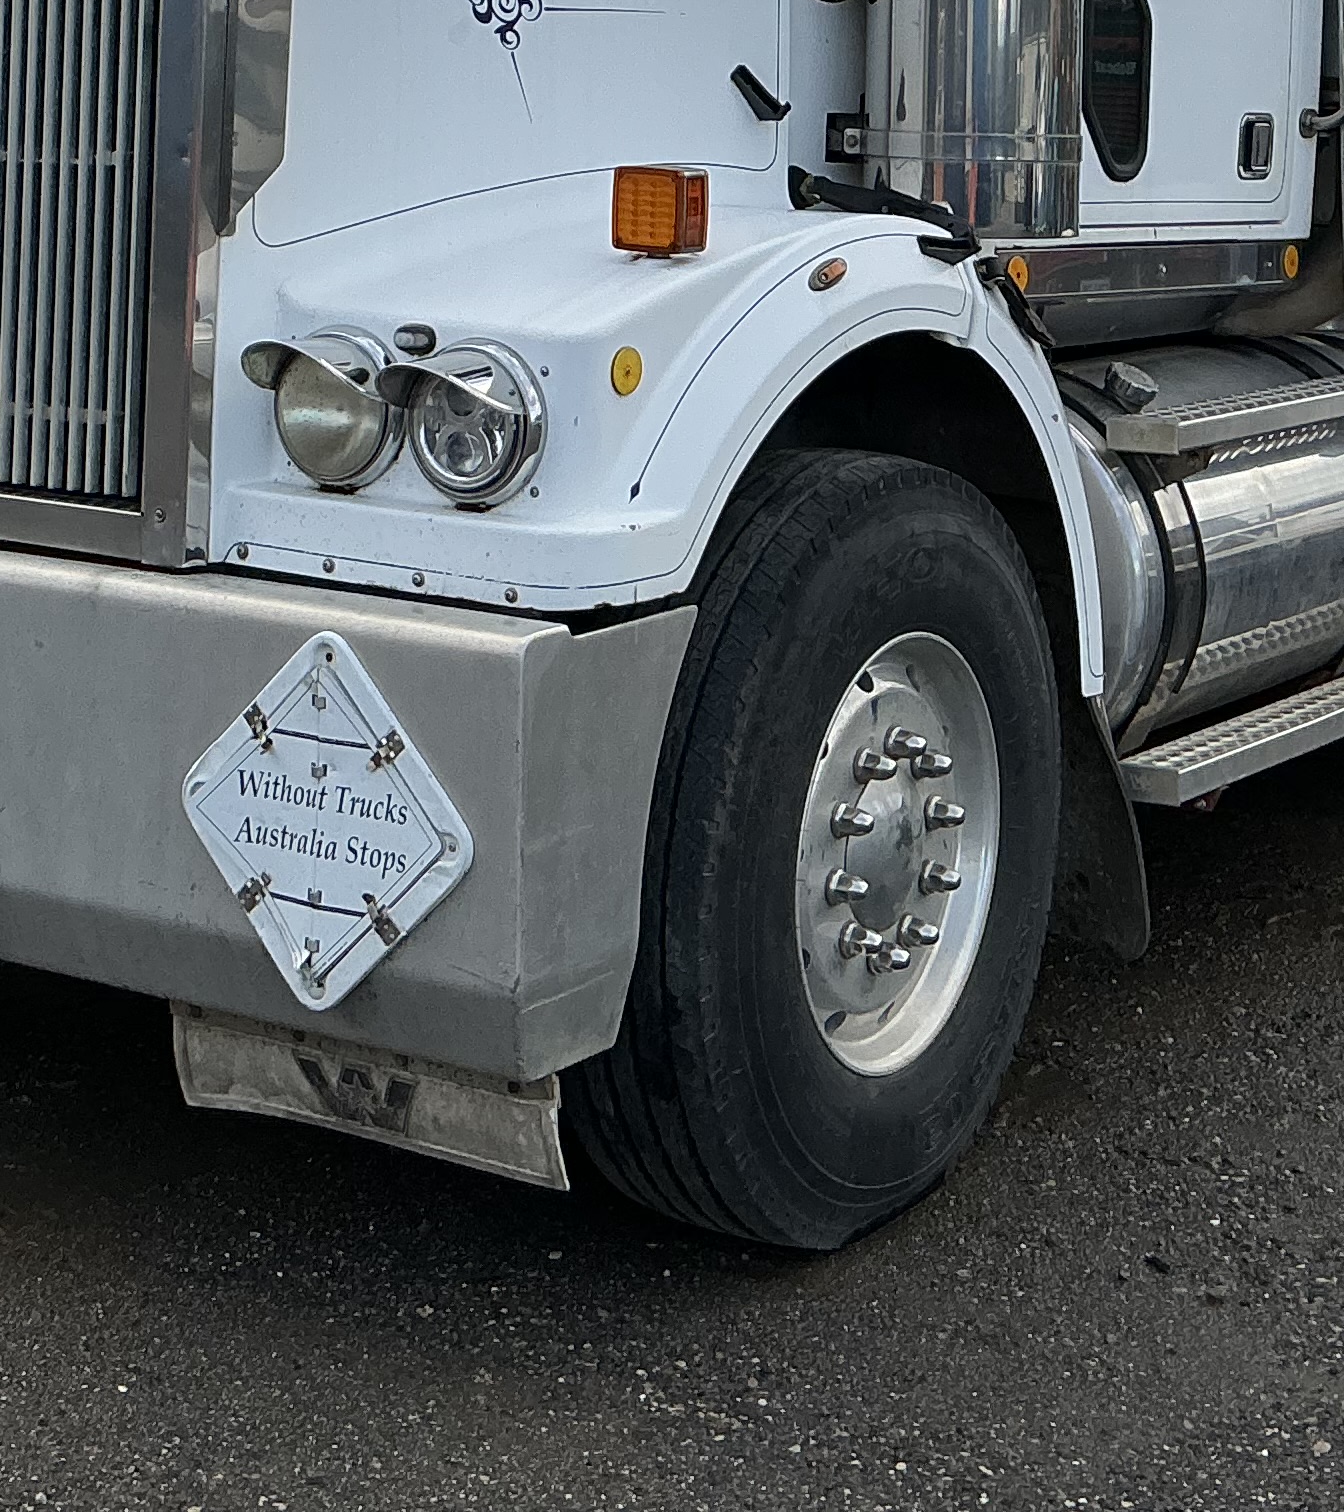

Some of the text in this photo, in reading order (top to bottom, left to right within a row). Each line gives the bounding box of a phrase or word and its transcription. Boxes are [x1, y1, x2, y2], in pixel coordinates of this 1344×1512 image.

[237, 769, 409, 826] Without Trucks
[234, 816, 408, 880] Australia Stops
